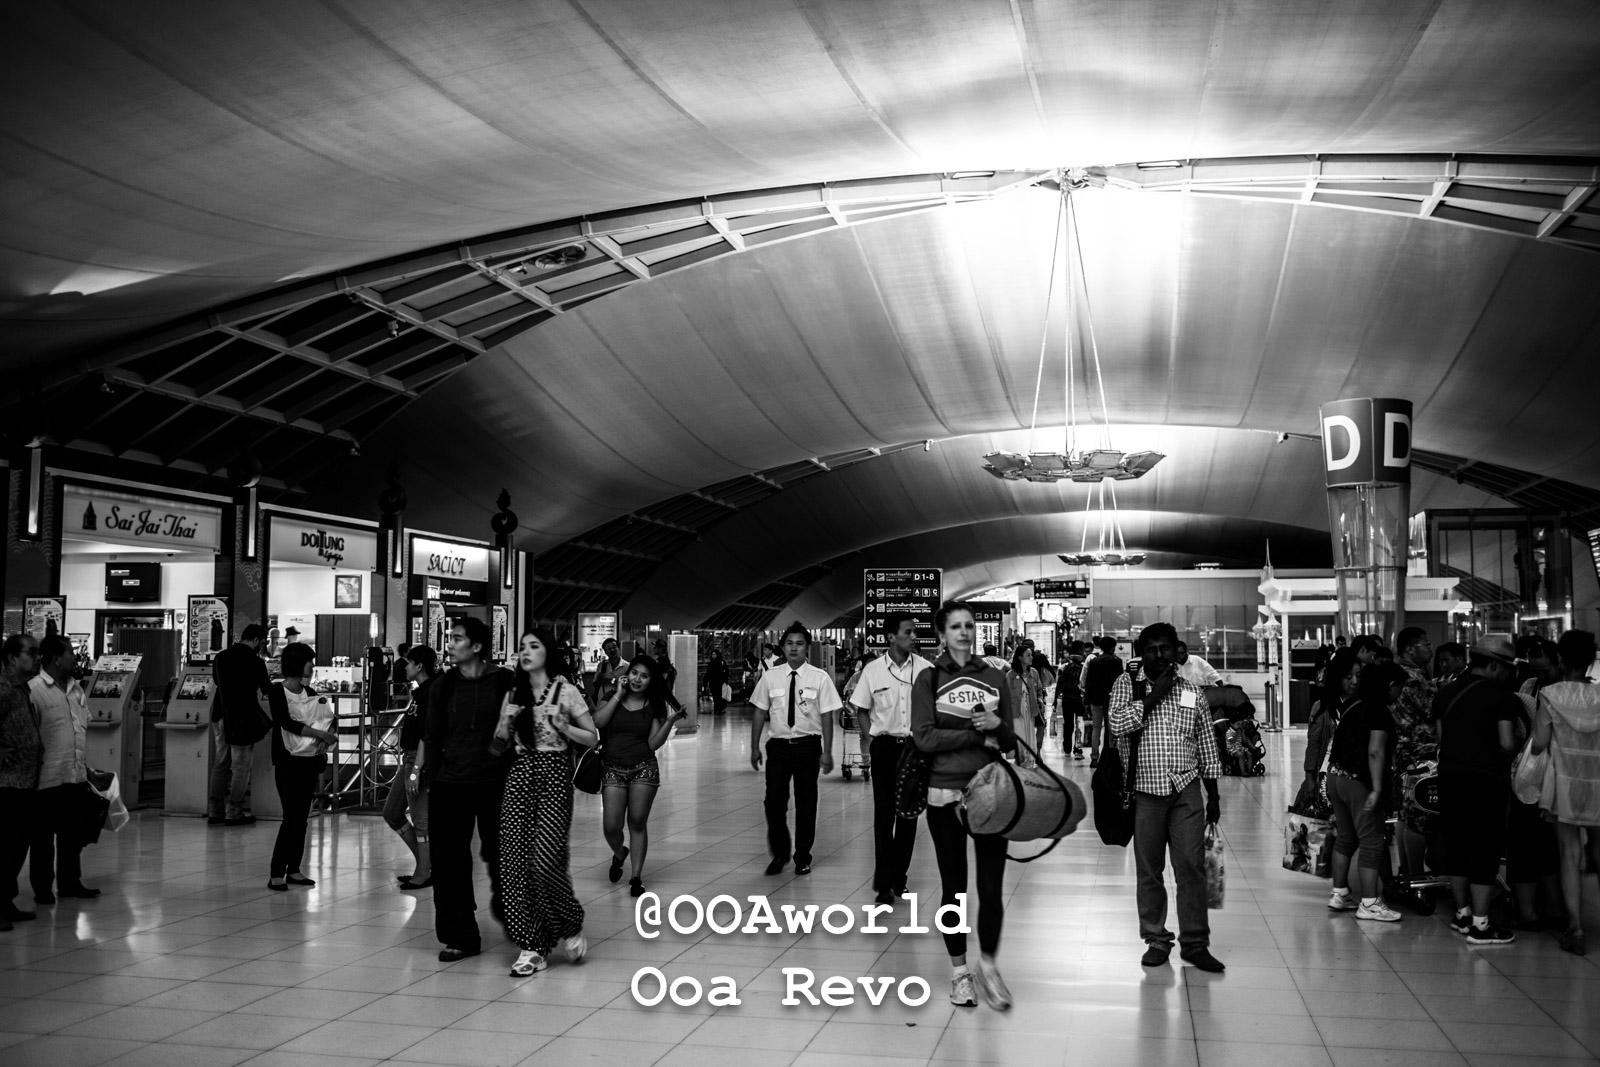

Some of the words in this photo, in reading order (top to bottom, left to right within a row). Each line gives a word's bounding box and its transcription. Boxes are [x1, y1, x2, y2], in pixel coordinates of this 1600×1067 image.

[1323, 415, 1361, 472] D
[1383, 412, 1411, 468] D
[106, 505, 136, 531] Sai
[135, 509, 162, 536] Jai
[163, 514, 198, 539] Thai
[427, 553, 466, 575] SACICT
[914, 573, 921, 581] D
[922, 573, 935, 581] 1-8
[948, 691, 986, 704] G-STAR
